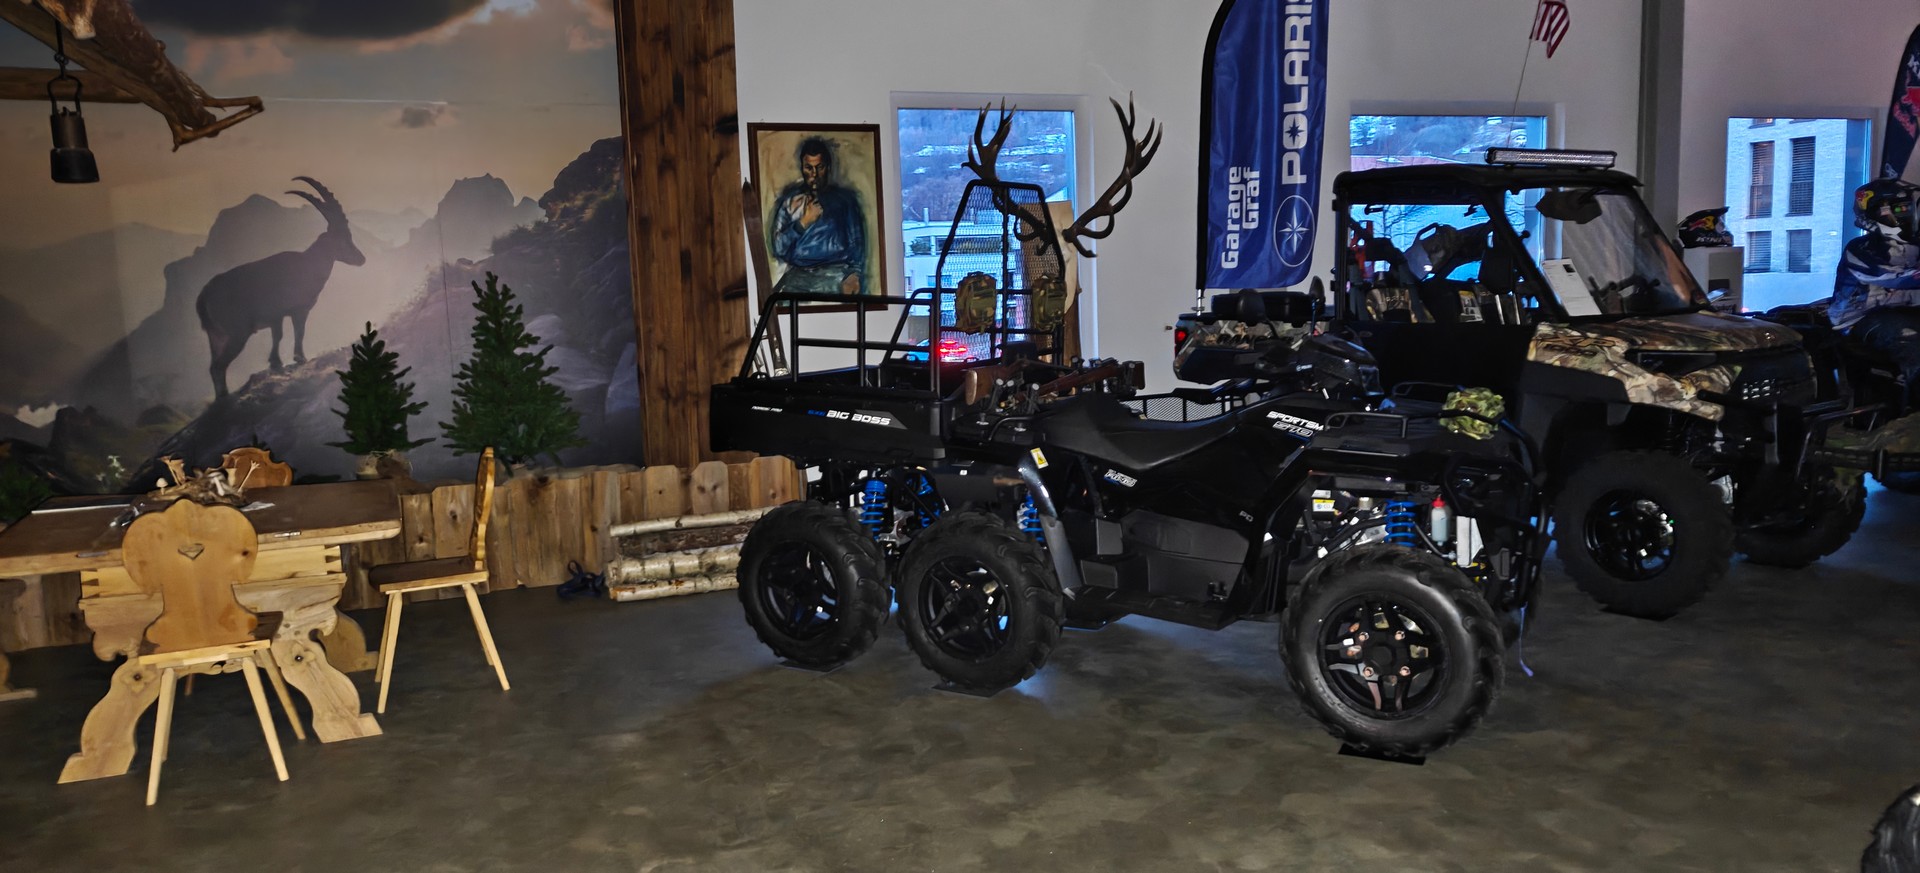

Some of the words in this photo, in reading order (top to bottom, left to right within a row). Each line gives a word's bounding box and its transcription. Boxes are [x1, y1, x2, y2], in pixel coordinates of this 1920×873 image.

[1281, 0, 1312, 185] POLARI
[1221, 166, 1247, 269] Garage
[1242, 166, 1260, 230] Graf
[826, 409, 850, 420] BIG
[851, 413, 891, 425] BOSS
[1266, 410, 1324, 431] SPORTSM
